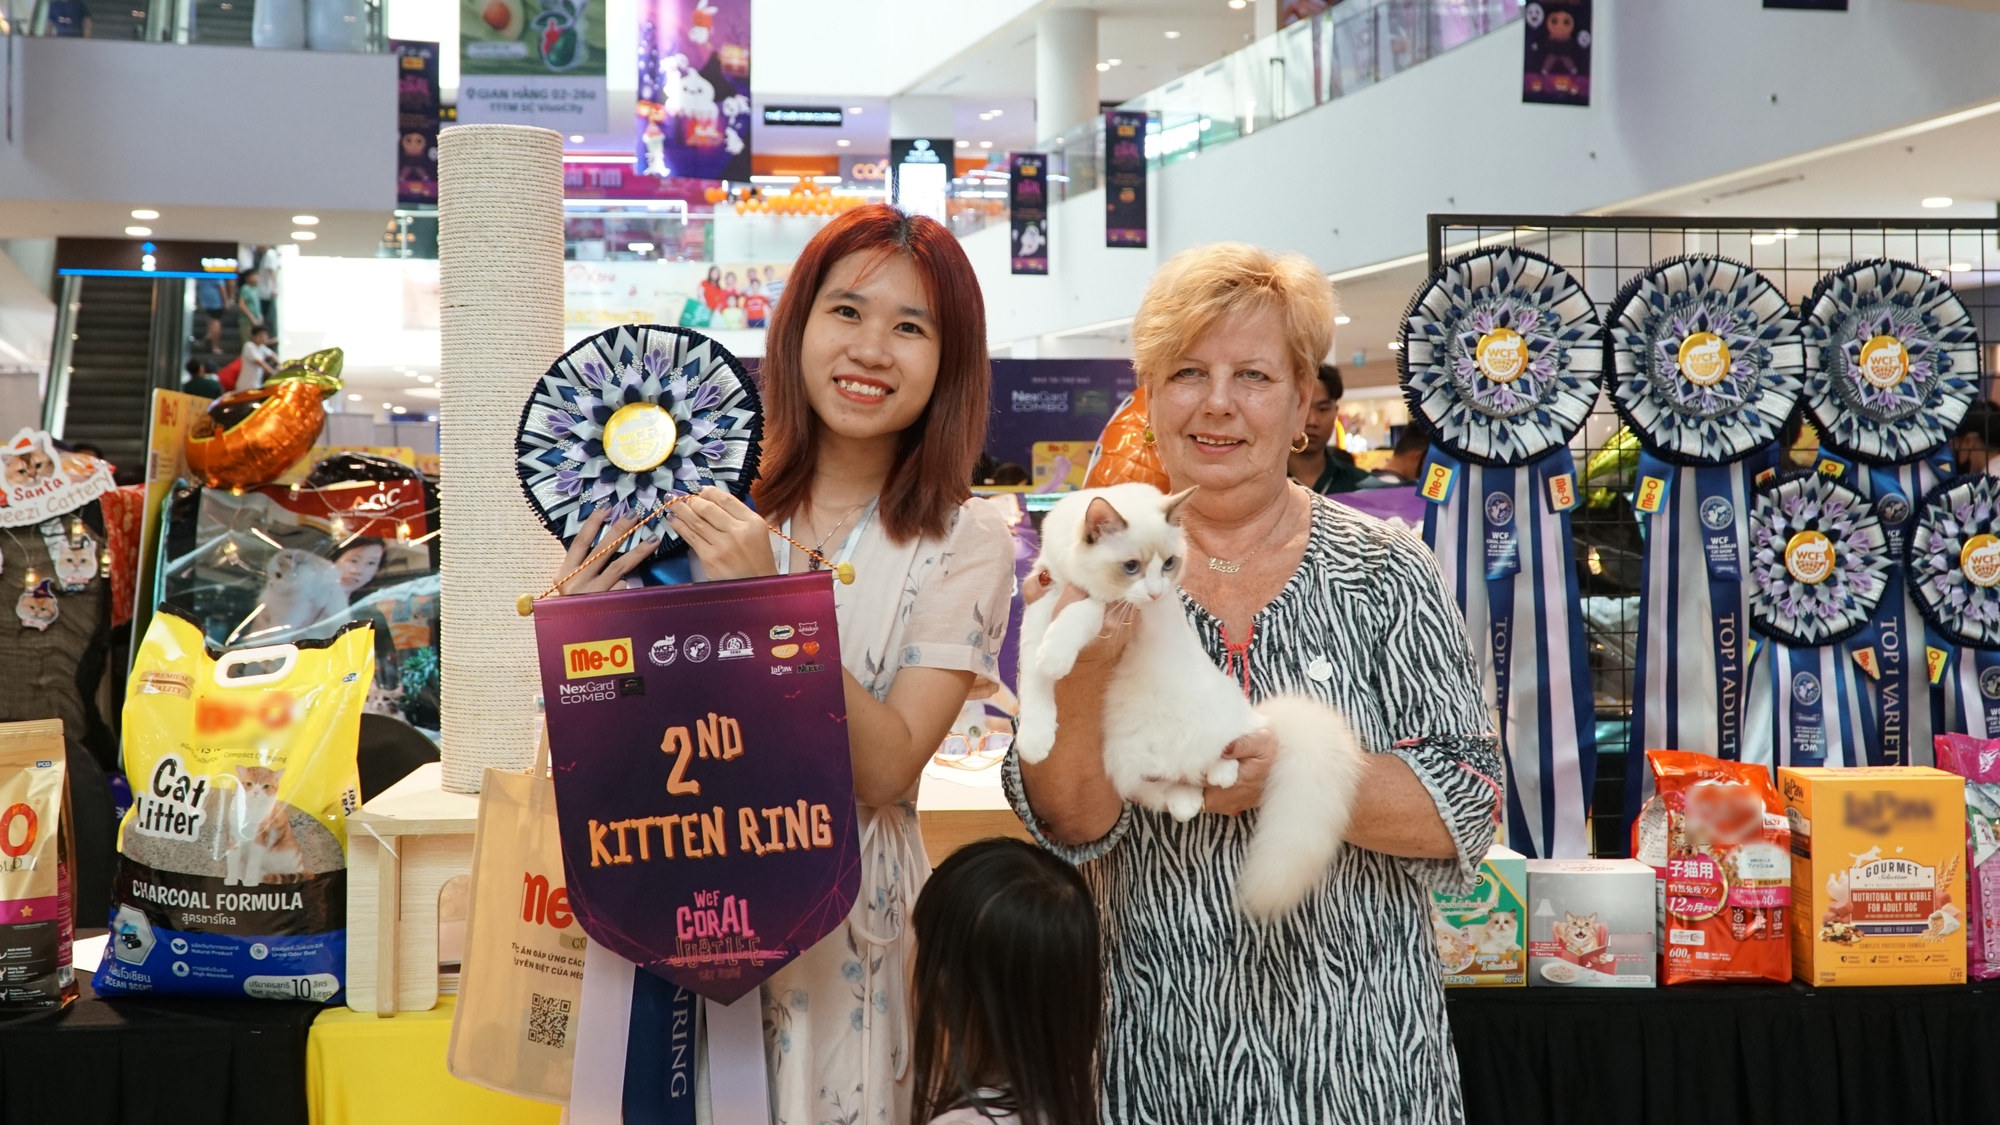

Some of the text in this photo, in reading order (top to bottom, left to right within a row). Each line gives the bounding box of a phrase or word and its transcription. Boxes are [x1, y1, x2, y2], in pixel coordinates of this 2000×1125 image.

[1487, 348, 1515, 358] WCF
[1689, 353, 1717, 362] WCF
[1870, 356, 1897, 365] WCF
[616, 427, 655, 445] WCF
[14, 476, 63, 501] Santa
[1427, 467, 1446, 499] Me-O
[1555, 477, 1570, 505] Me-O
[46, 471, 111, 513] Cattery
[1641, 480, 1658, 510] Me-O
[1492, 531, 1510, 540] WCF
[1710, 536, 1729, 545] WCF
[1796, 551, 1824, 561] WCF
[1971, 555, 1998, 564] WCF
[1495, 617, 1508, 664] TOP
[1880, 616, 1900, 669] TOP
[570, 643, 628, 673] Me-O
[150, 672, 189, 682] PREMIUM
[771, 665, 793, 676] LaPaw
[1885, 668, 1900, 676] 1
[559, 680, 615, 696] NexGard
[1719, 612, 1737, 754] TOP 1 ADULT
[560, 692, 616, 705] COMBO
[223, 751, 254, 760] Compact
[660, 712, 744, 796] 2ND
[153, 758, 206, 804] Cat
[137, 796, 200, 837] Litter
[588, 799, 834, 868] KITTEN RING
[1669, 860, 1714, 879] 子猫用
[1865, 861, 1919, 878] GOURMET
[132, 879, 304, 912] CHARCOAL FORMULA
[693, 889, 720, 909] WCF
[1895, 891, 1908, 902] MIX
[1909, 891, 1932, 901] KIBBLE
[1867, 902, 1918, 913] FOR ADULT DOG
[676, 894, 756, 942] CORAL
[191, 948, 211, 956] Natural
[547, 952, 567, 964] ỨNG
[669, 935, 764, 969] JUBILEE
[1669, 947, 1692, 959] 600g
[105, 975, 127, 989] OCEAN
[206, 972, 235, 980] Absorbent
[291, 978, 312, 999] 10
[313, 990, 333, 998] Liters
